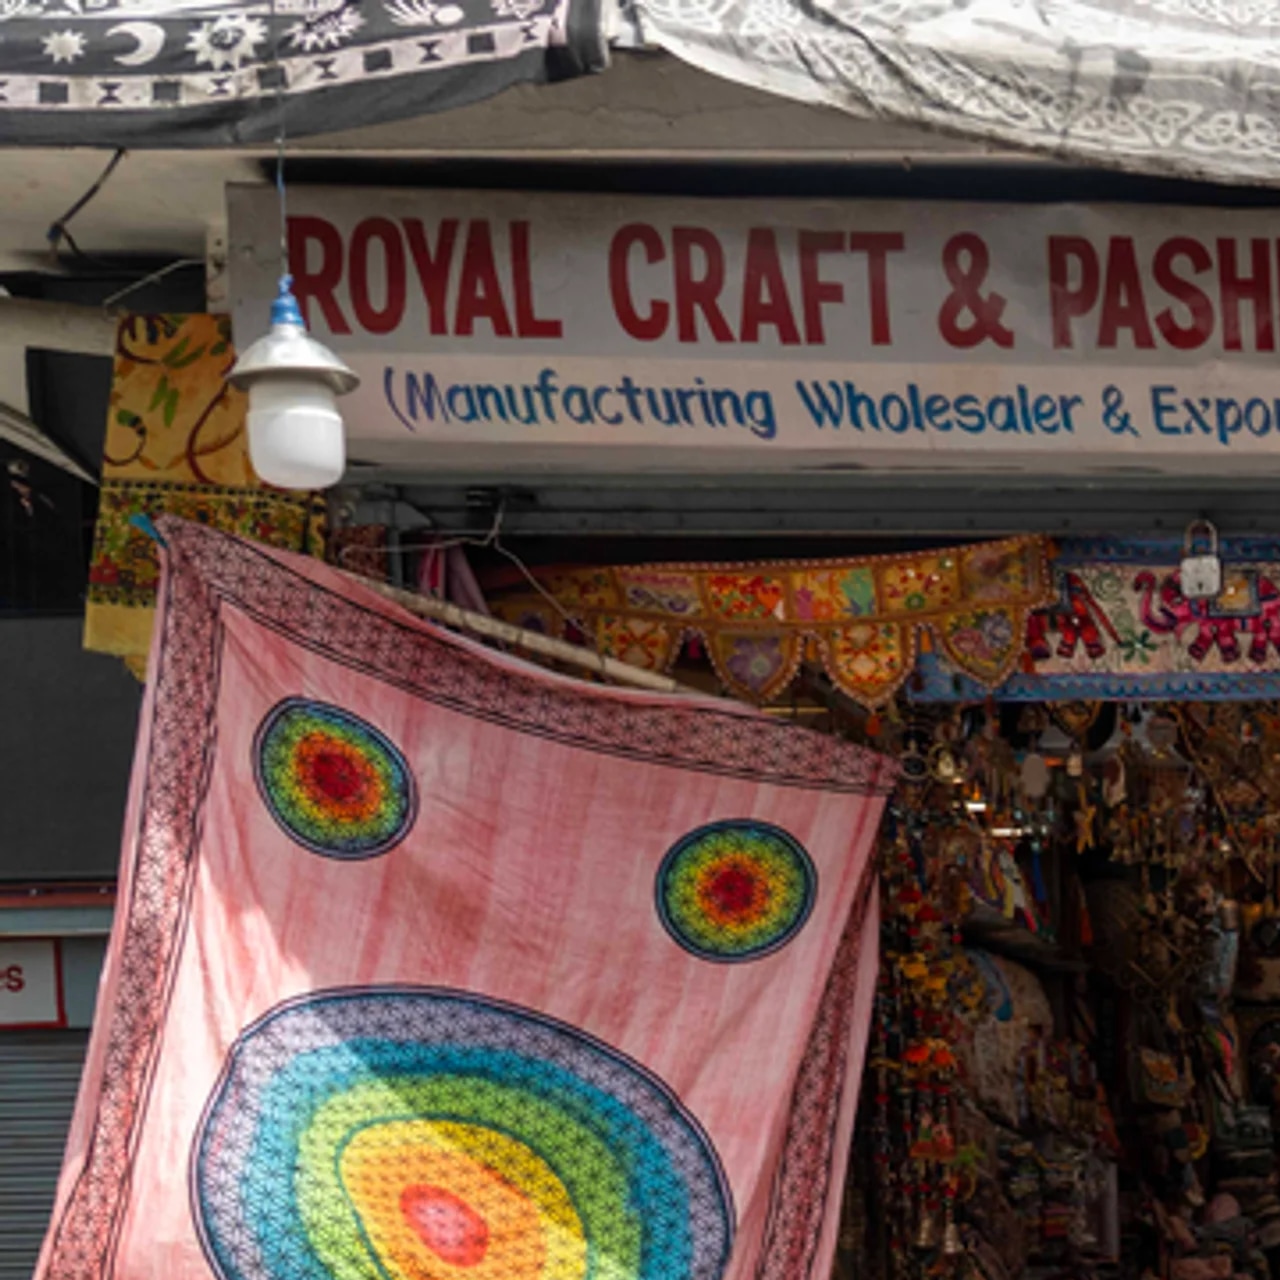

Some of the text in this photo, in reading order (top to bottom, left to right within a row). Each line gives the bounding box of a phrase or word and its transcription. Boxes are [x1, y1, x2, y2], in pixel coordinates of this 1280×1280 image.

[285, 215, 563, 340] ROYAL
[607, 221, 905, 347] CRAFT
[937, 231, 1015, 350] &
[383, 366, 777, 440] (Manufacturing
[795, 378, 1083, 437] Wholesaler
[1101, 384, 1141, 438] &
